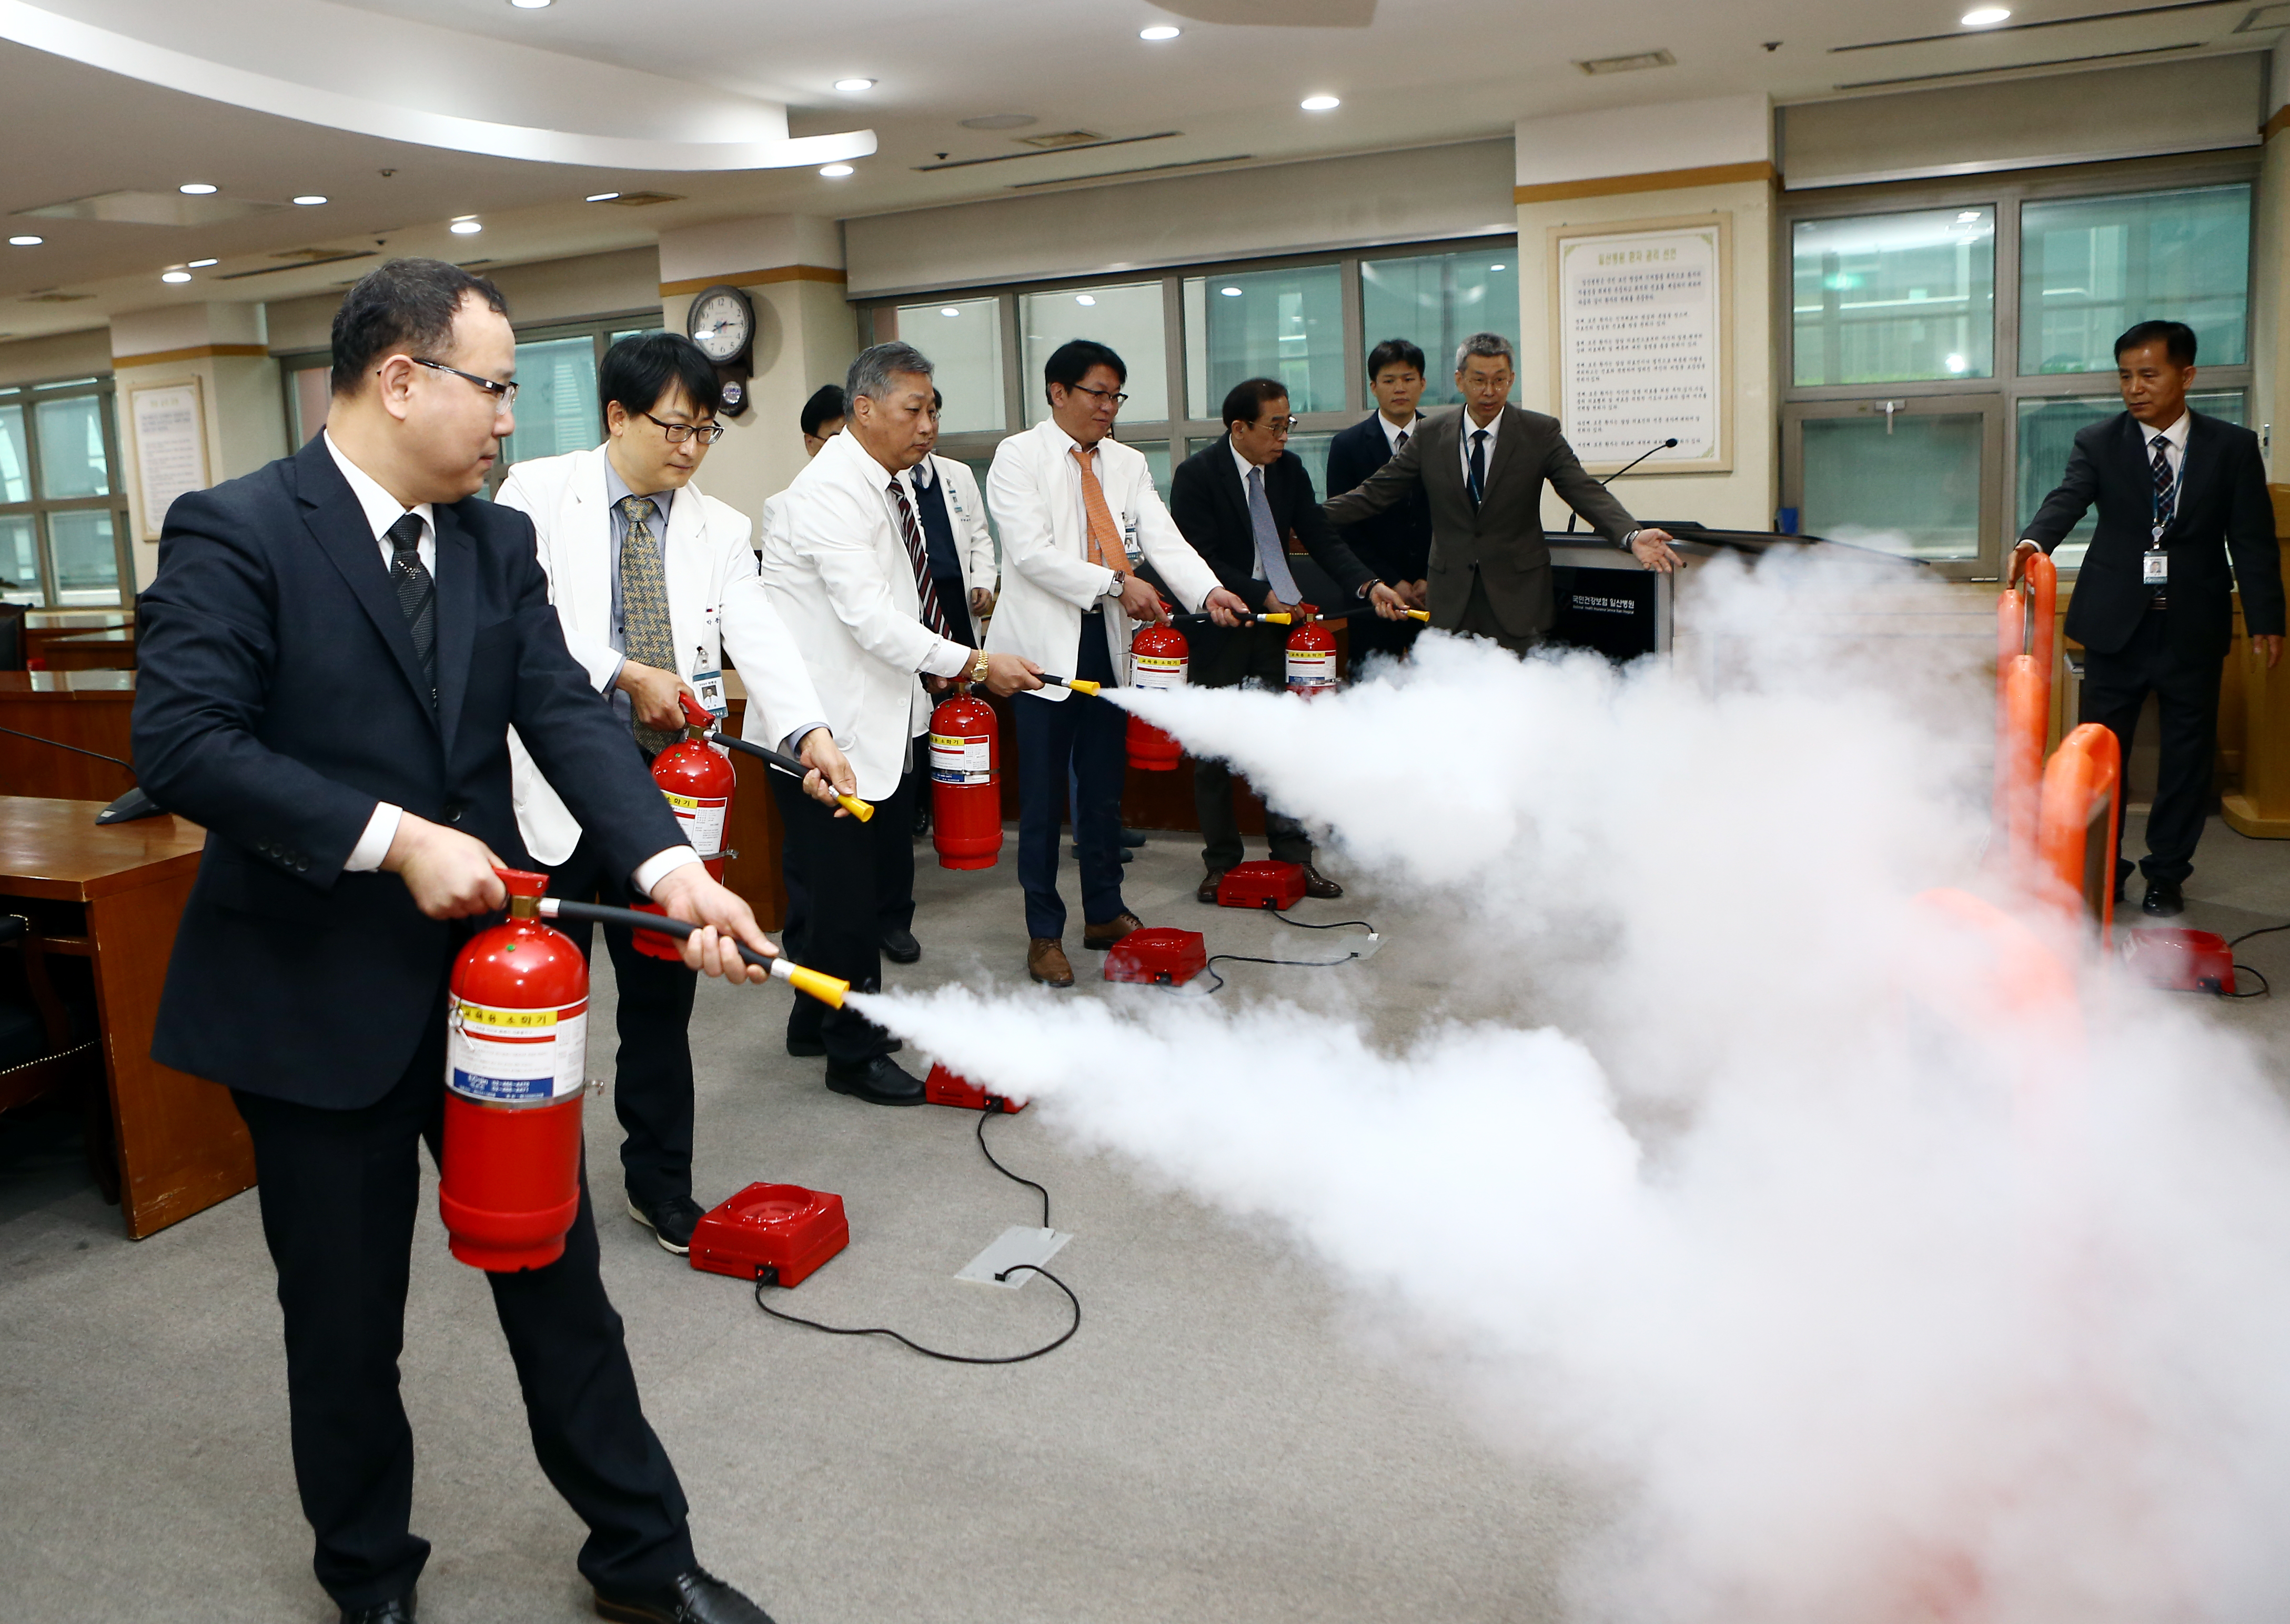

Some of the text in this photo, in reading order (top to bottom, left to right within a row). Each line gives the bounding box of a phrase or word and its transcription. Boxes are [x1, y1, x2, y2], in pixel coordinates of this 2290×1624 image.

[737, 308, 741, 317] 2
[1573, 596, 1635, 609] 국민건강보험 일산병원
[507, 1015, 547, 1025] 소화기
